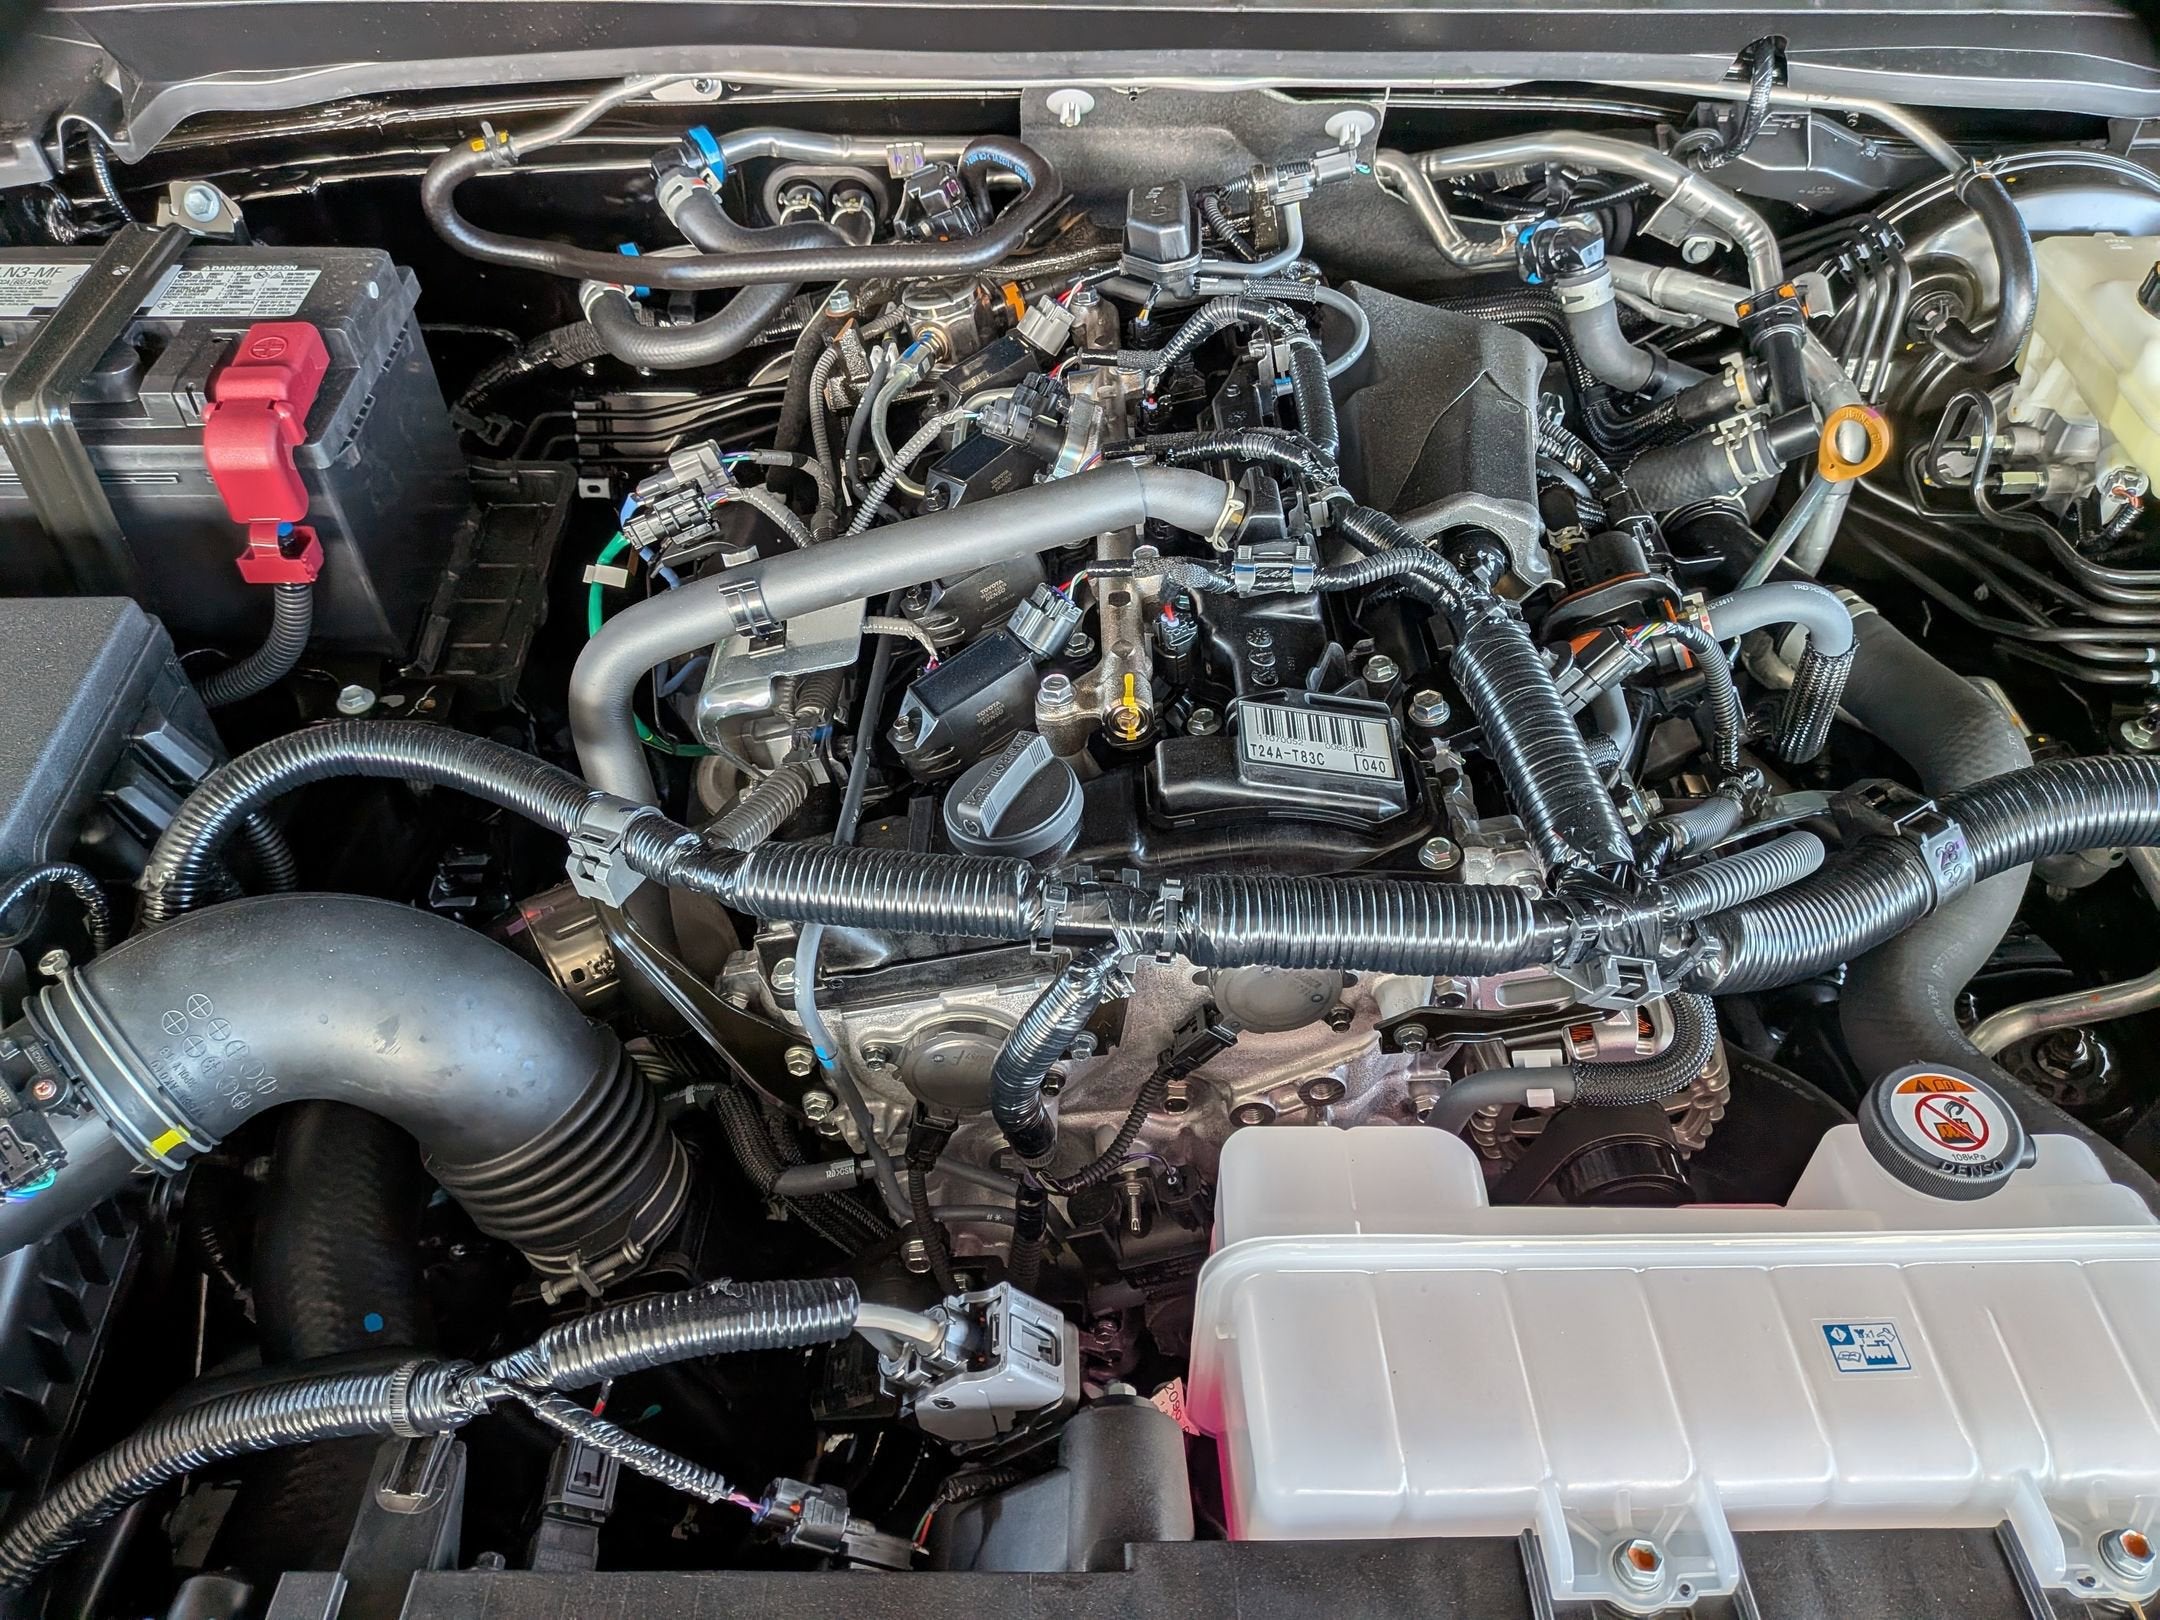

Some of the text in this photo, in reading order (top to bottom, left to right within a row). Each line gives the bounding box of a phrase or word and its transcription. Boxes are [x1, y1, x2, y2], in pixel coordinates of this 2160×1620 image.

[0, 266, 66, 278] N3-MF
[980, 579, 1005, 594] TOYOTA
[985, 587, 1006, 602] DENSO
[976, 700, 1001, 717] TOYOTA
[1250, 744, 1325, 766] T24A-T83C
[1362, 759, 1386, 774] 040
[1951, 1153, 1988, 1162] 108kPa
[1940, 1159, 2006, 1178] DENSO
